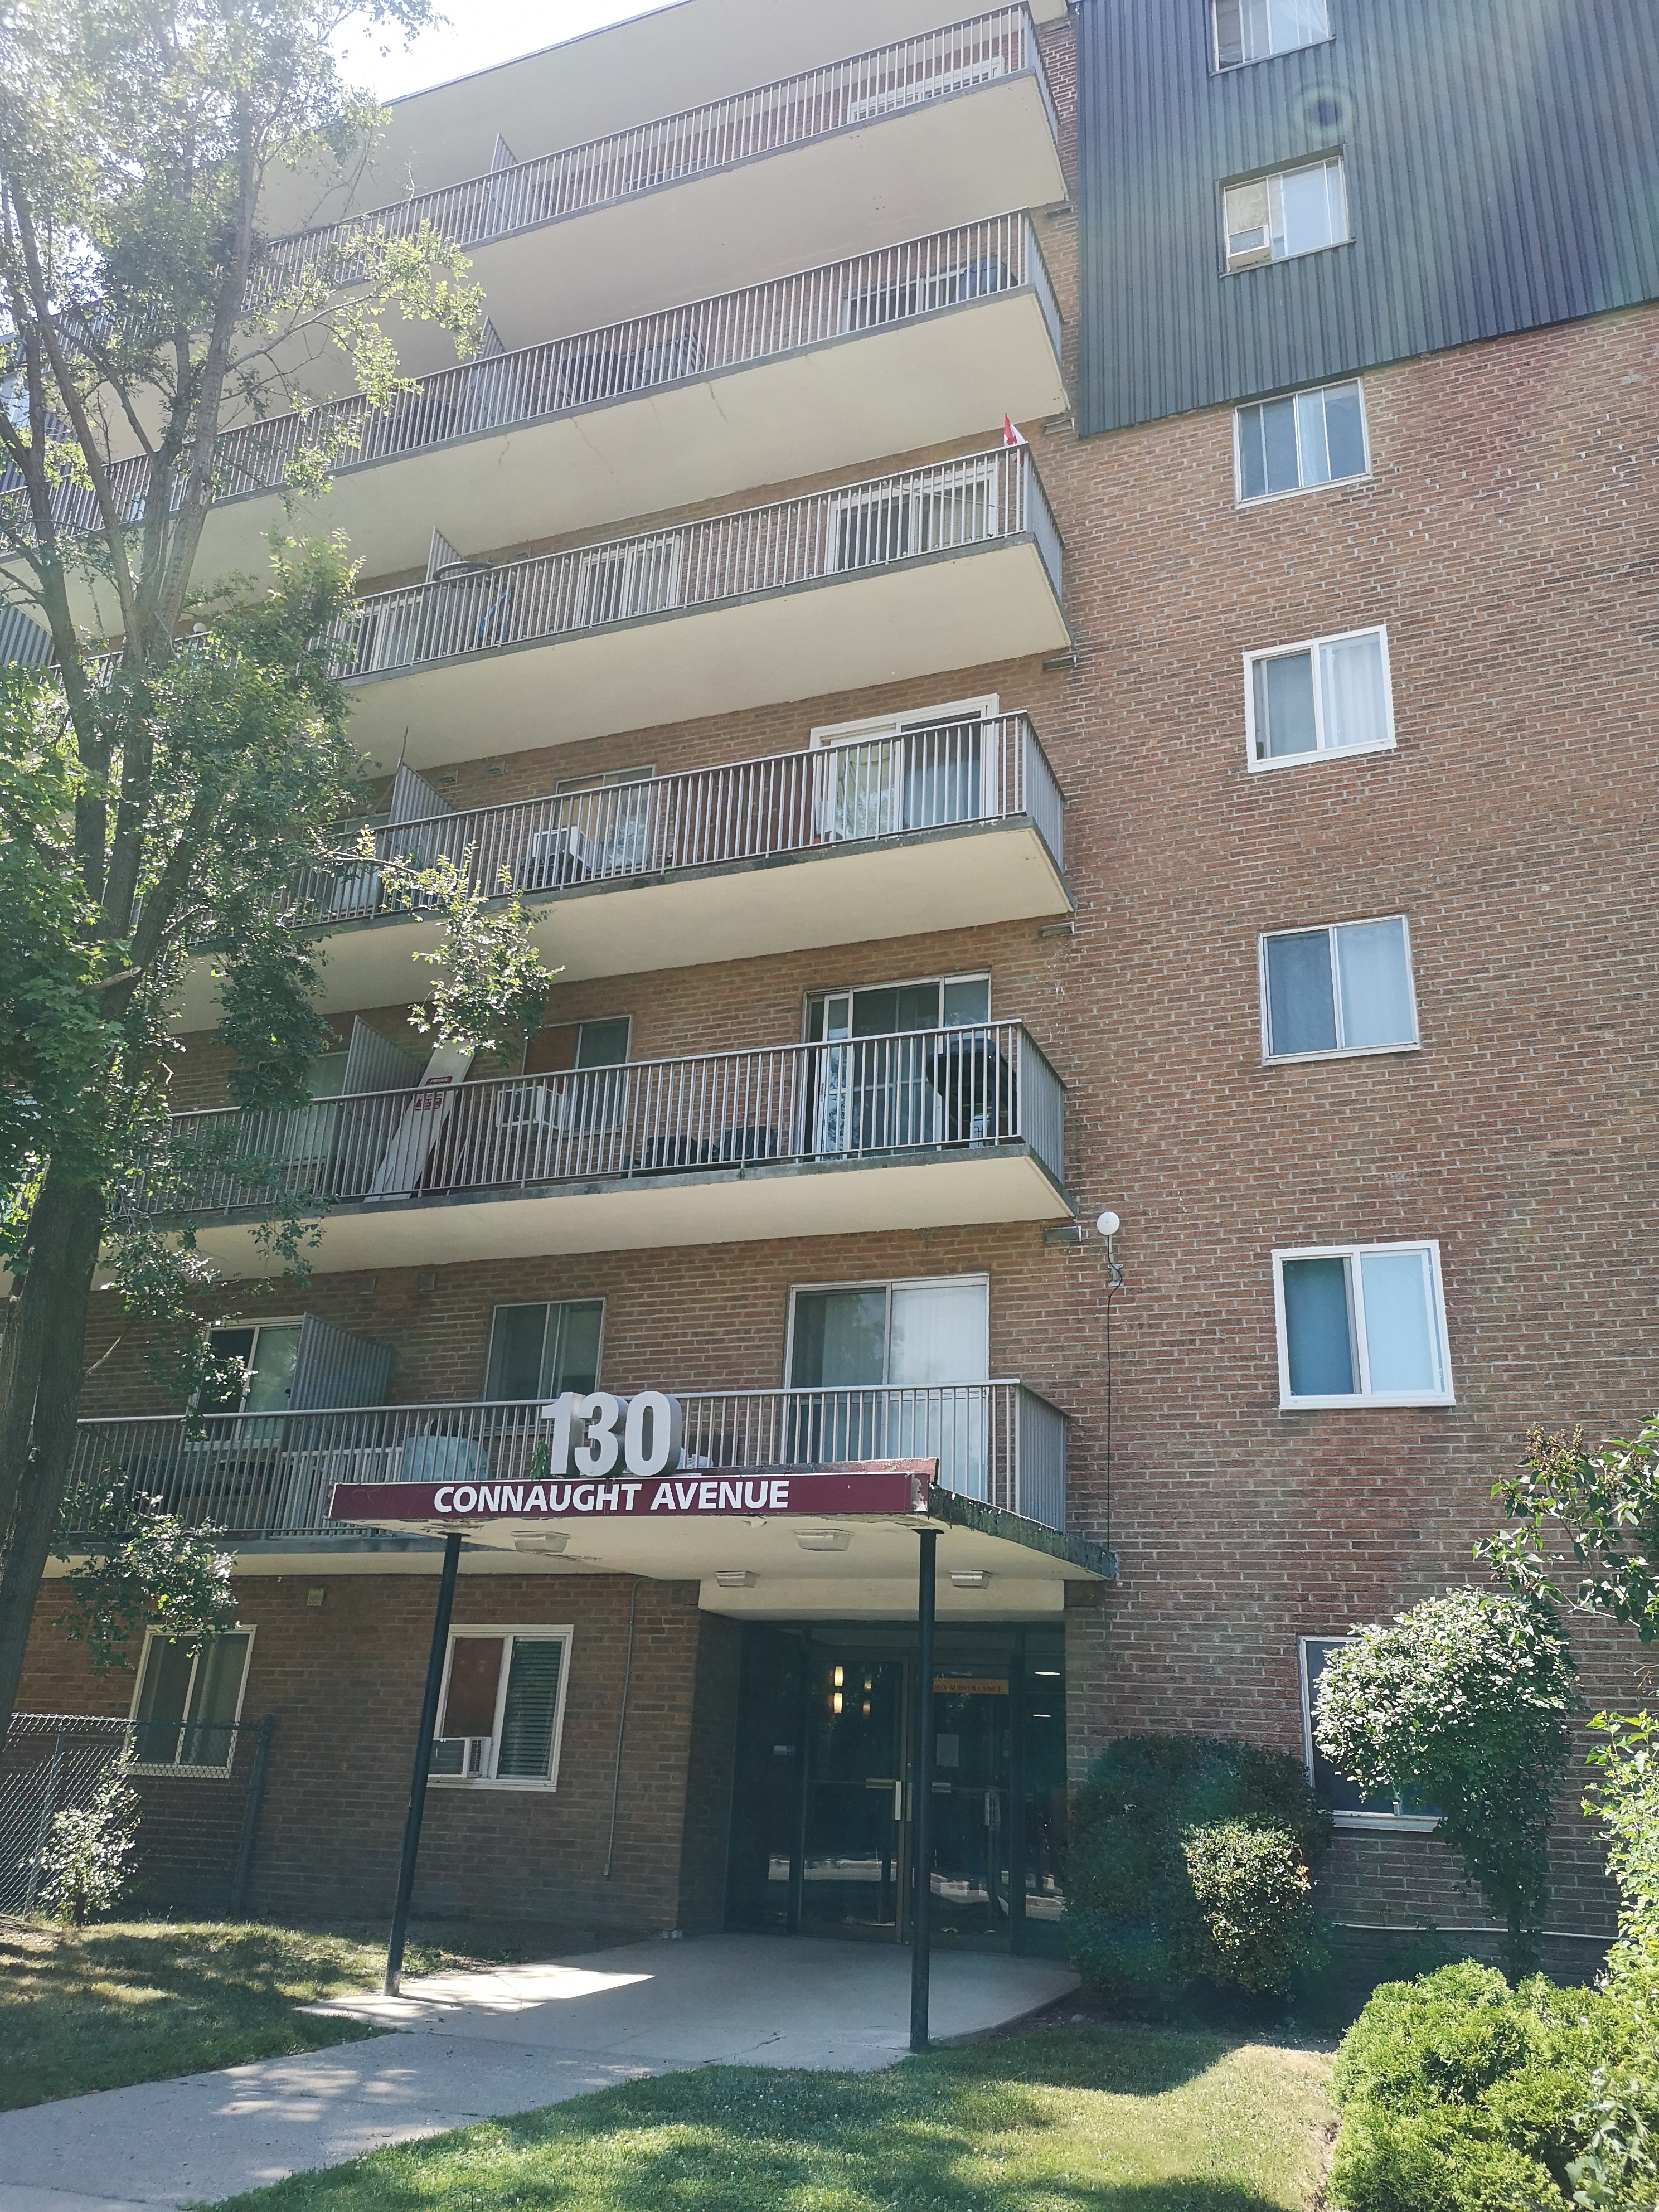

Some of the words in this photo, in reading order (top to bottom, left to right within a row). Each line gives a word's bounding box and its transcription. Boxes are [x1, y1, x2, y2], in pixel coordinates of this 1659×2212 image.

[541, 1390, 672, 1477] 130
[434, 1483, 642, 1513] CONNAUGHT
[650, 1481, 789, 1510] AVENUE
